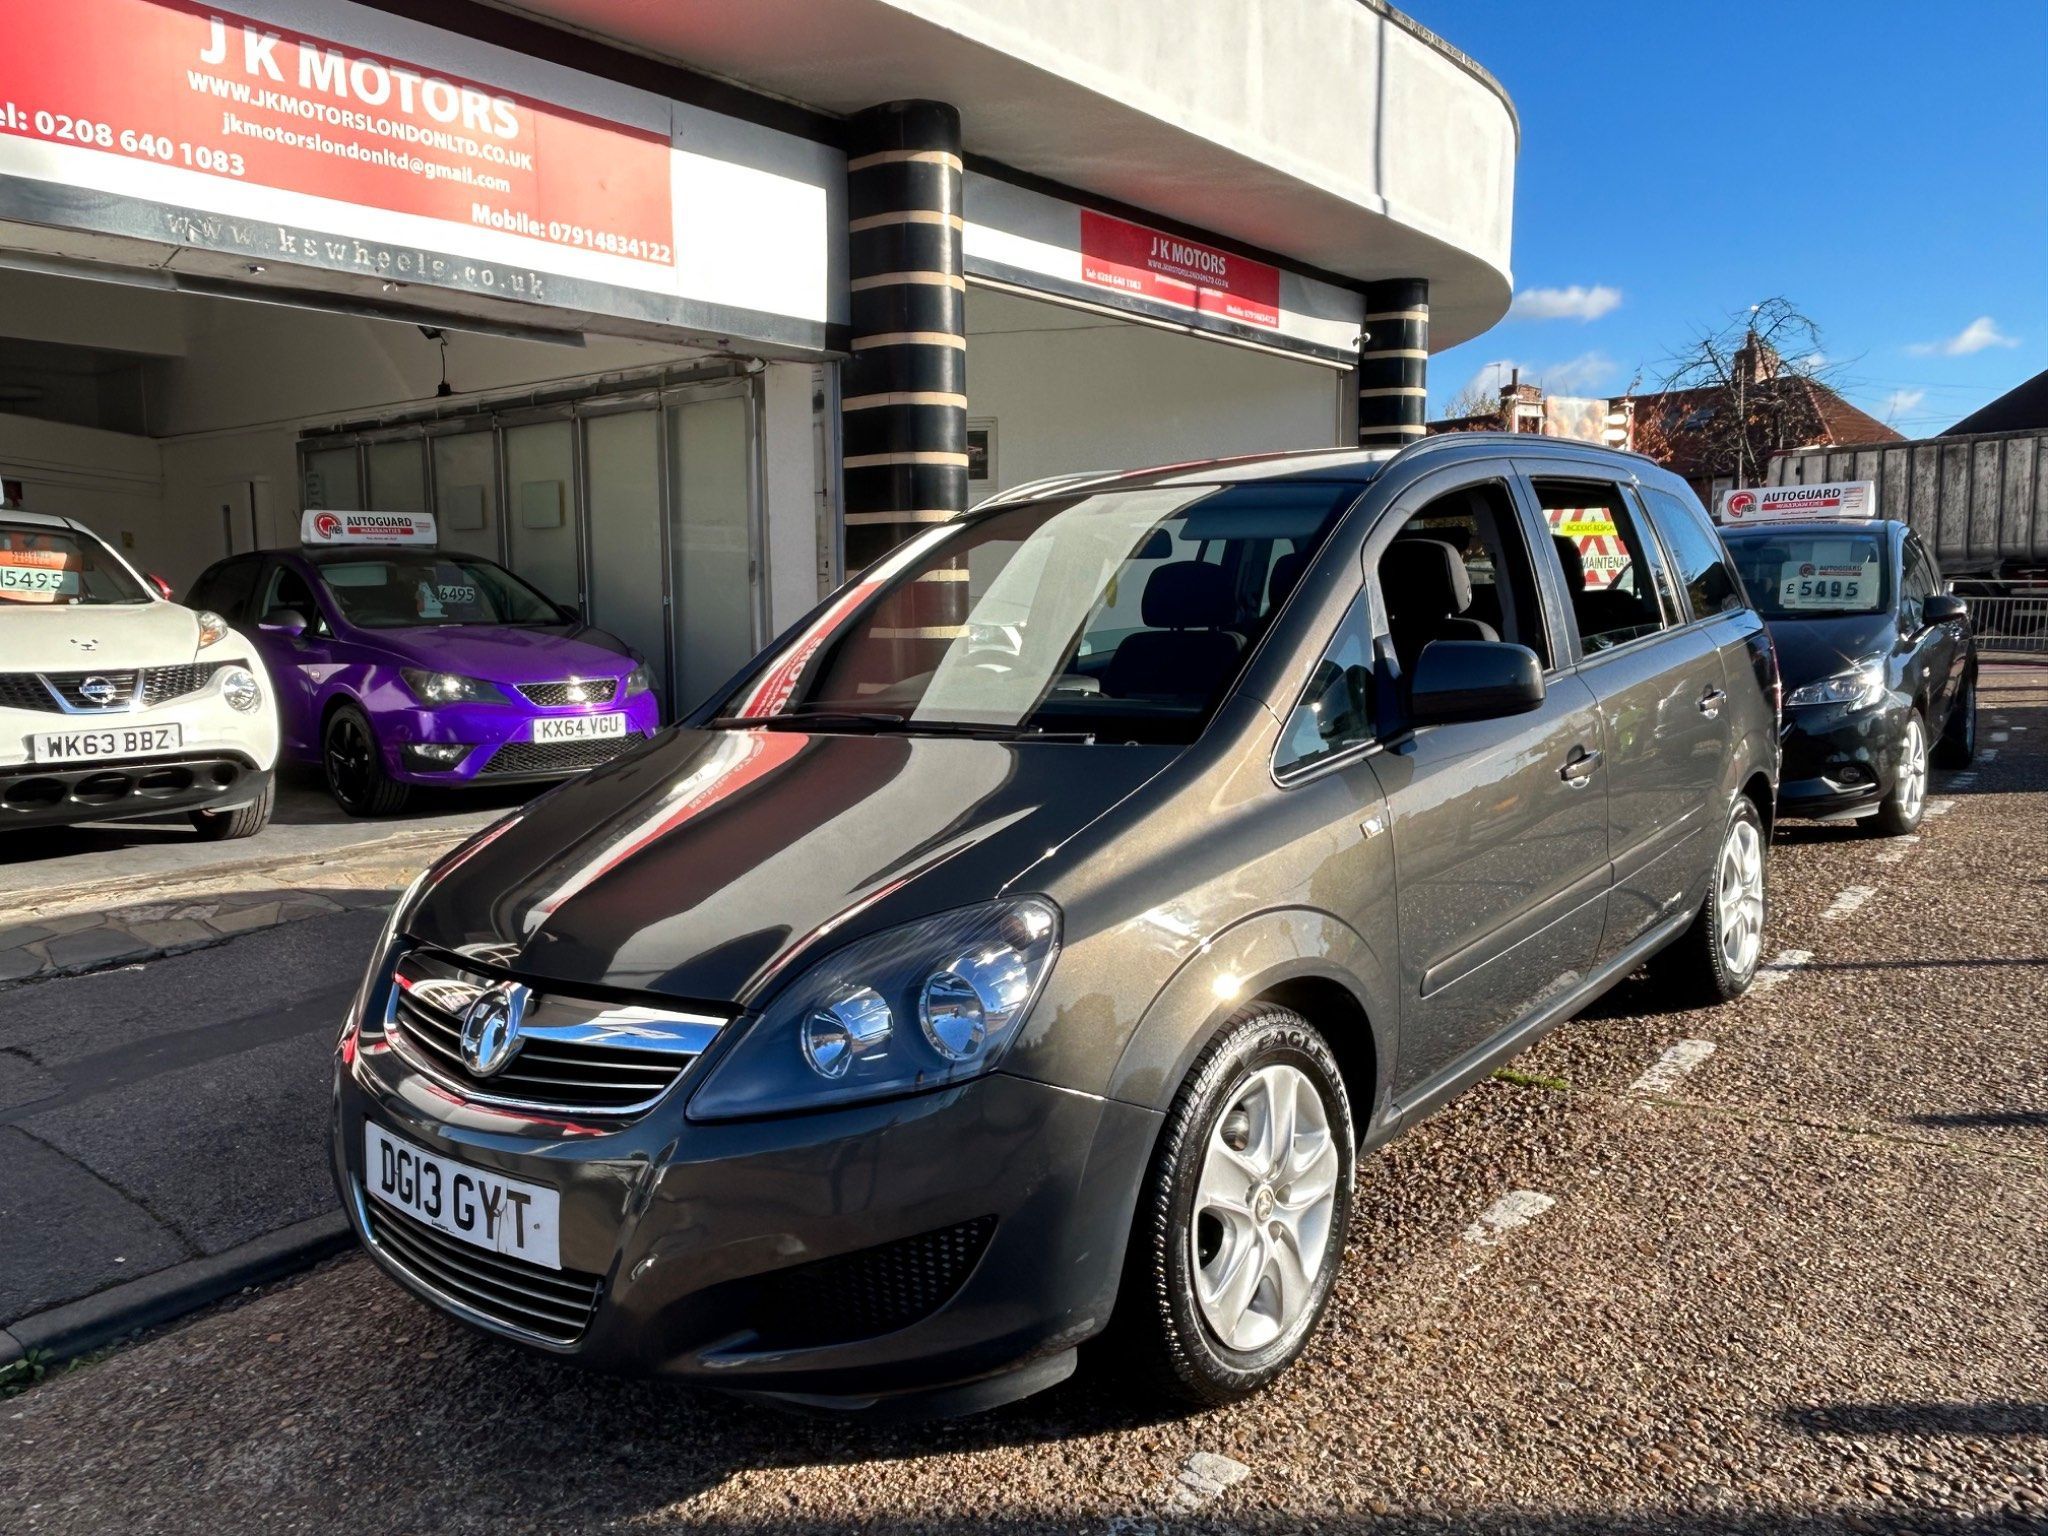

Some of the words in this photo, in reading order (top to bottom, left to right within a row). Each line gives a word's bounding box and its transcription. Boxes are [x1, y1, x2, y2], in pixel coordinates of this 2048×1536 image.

[200, 15, 227, 64] J
[244, 24, 285, 82] K
[298, 41, 519, 139] MOTORS
[187, 69, 532, 171] WWW.JKMOTORSLONDONLTD.CO.UK
[34, 110, 114, 147] 0208
[119, 129, 173, 160] 640
[180, 142, 245, 176] 1083
[222, 112, 511, 193] jkmotorslondonltd@gmail.com
[471, 202, 546, 238] Mobile:
[549, 221, 672, 263] 07914834122
[1151, 237, 1157, 256] J
[1160, 240, 1170, 260] K
[1172, 243, 1226, 276] MOTORS
[1763, 488, 1841, 502] AUTOGUARD
[347, 516, 412, 527] AUTOGUARD
[440, 587, 474, 601] 6495
[1786, 583, 1795, 594] £
[1800, 581, 1858, 598] 5495
[47, 733, 115, 758] WK63
[123, 729, 169, 753] BBZ
[542, 719, 584, 739] KX64
[590, 716, 619, 735] VGU
[380, 1138, 442, 1219] DG13
[453, 1173, 532, 1249] GYT
